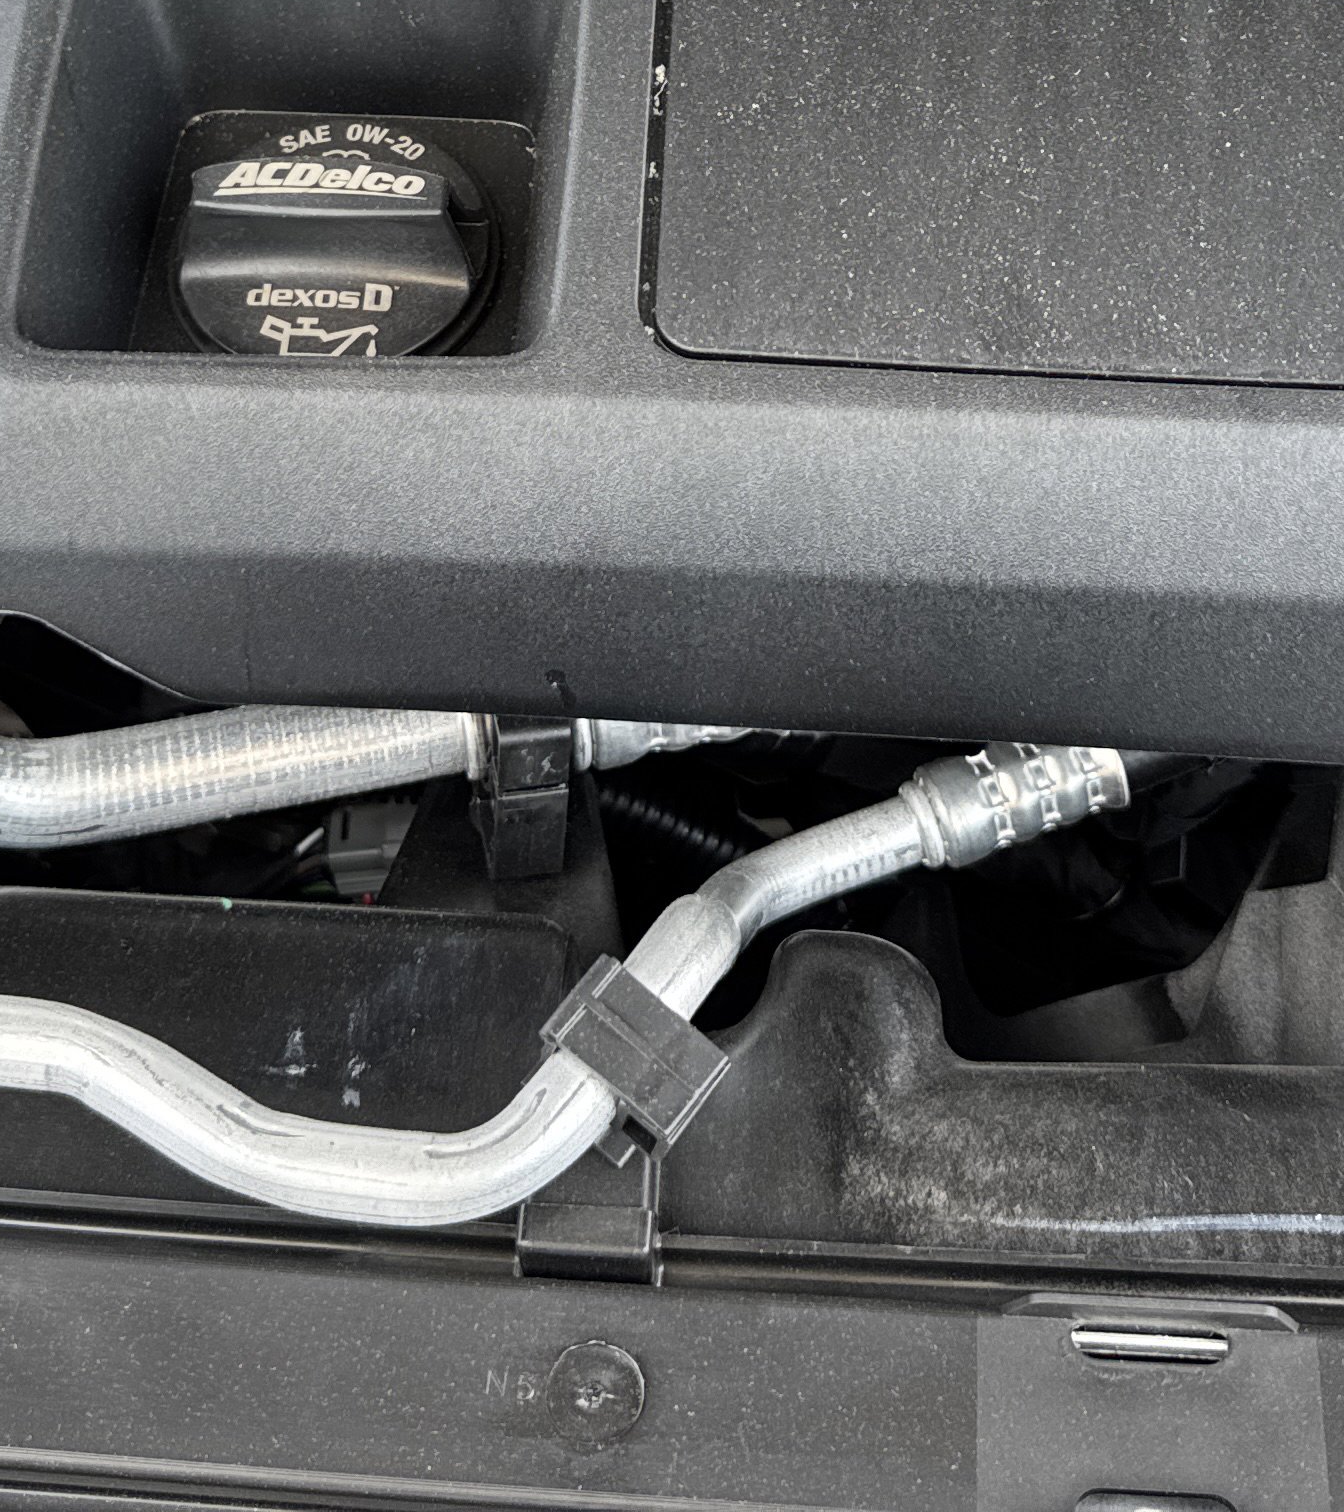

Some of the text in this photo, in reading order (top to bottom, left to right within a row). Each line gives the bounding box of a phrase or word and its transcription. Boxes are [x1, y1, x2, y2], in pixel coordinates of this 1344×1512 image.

[279, 123, 426, 161] SAE 0W-20
[217, 161, 427, 196] ACDelco
[246, 283, 393, 312] dexosD
